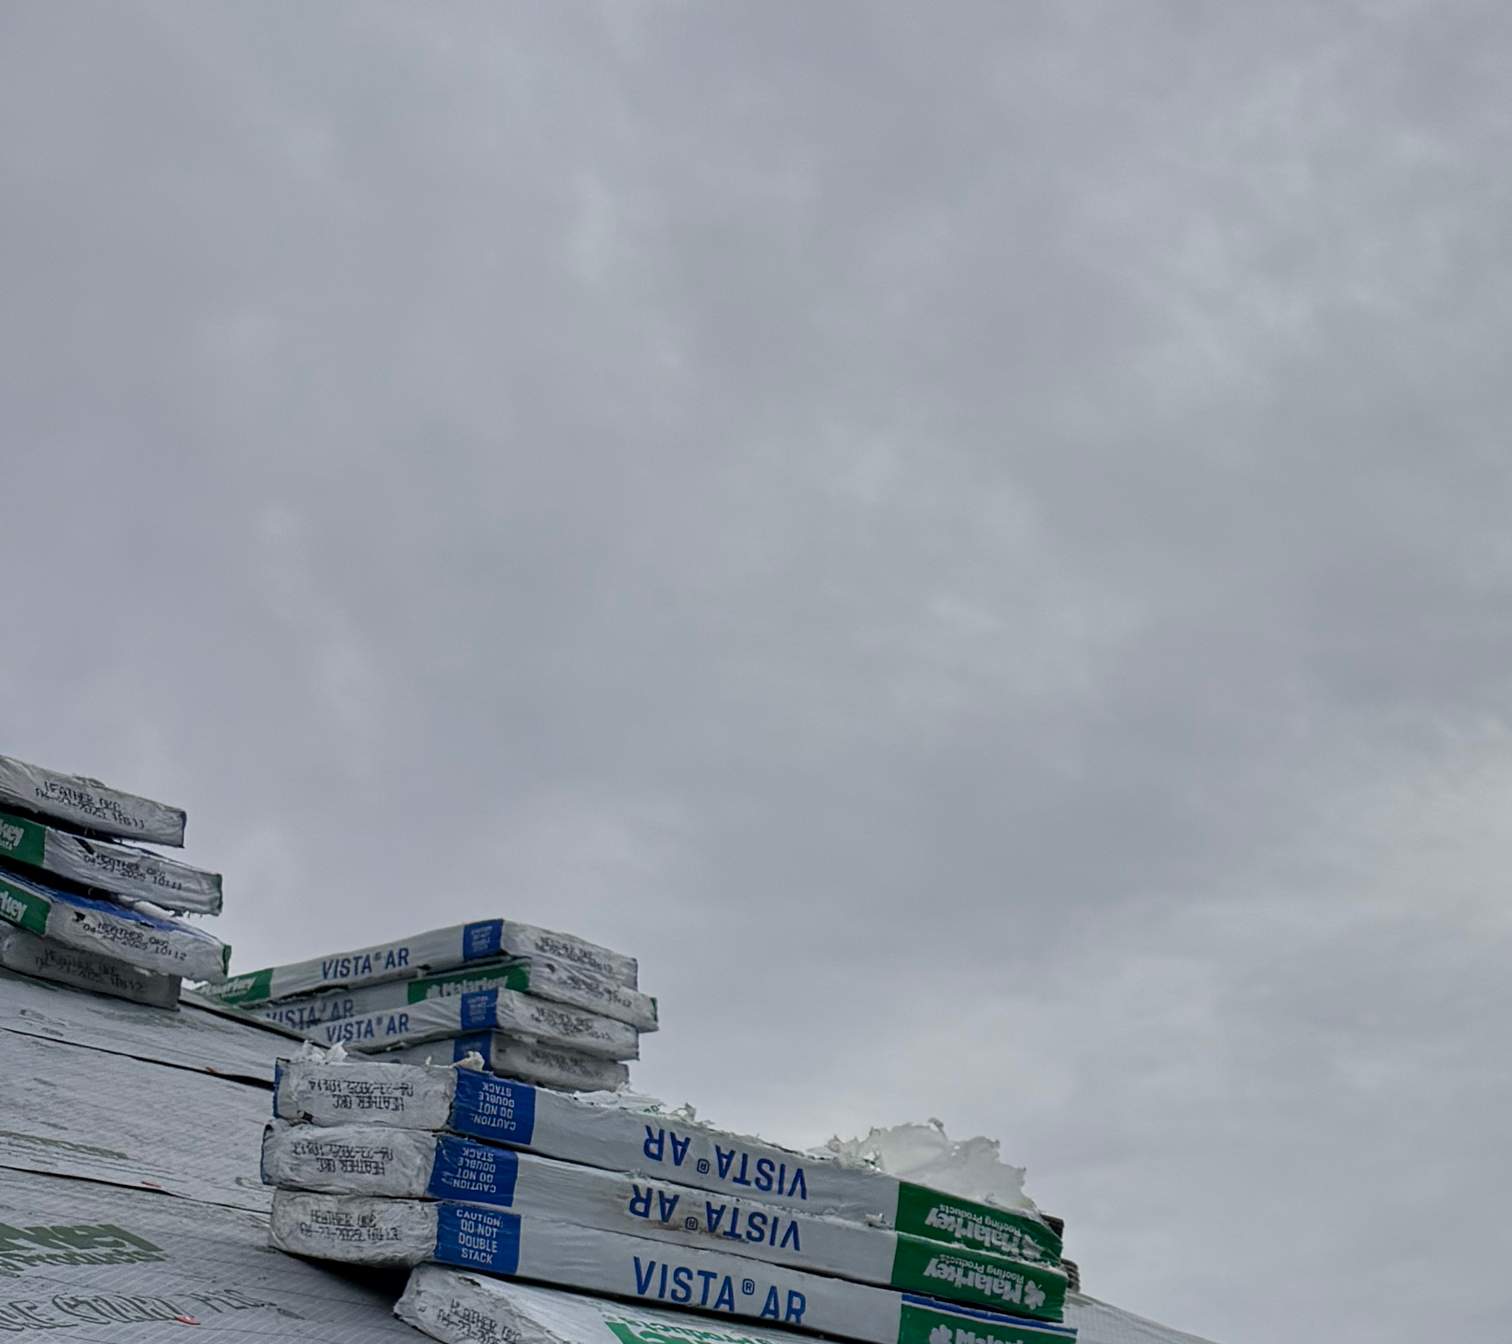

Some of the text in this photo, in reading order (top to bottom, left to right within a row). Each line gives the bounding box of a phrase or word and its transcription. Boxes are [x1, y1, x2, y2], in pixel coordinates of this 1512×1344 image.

[385, 948, 410, 970] AR
[386, 1013, 410, 1036] AR
[479, 1090, 515, 1108] DOUBLE
[482, 1081, 512, 1097] STACK
[479, 1102, 513, 1120] DO NOT
[462, 1147, 494, 1162] STACK
[643, 1125, 691, 1167] AR
[456, 1167, 494, 1183] DO NOT
[457, 1157, 496, 1173] DOUBLE
[628, 1183, 680, 1223] AR
[461, 1219, 498, 1238] DO NOT
[925, 1207, 1020, 1253] Malarkey
[940, 1204, 1021, 1237] Roofing Products
[458, 1232, 498, 1253] DOUBLE
[461, 1248, 493, 1264] STACK
[923, 1258, 1022, 1304] Malarkey
[986, 1265, 1024, 1284] Roofing
[761, 1285, 806, 1323] AR
